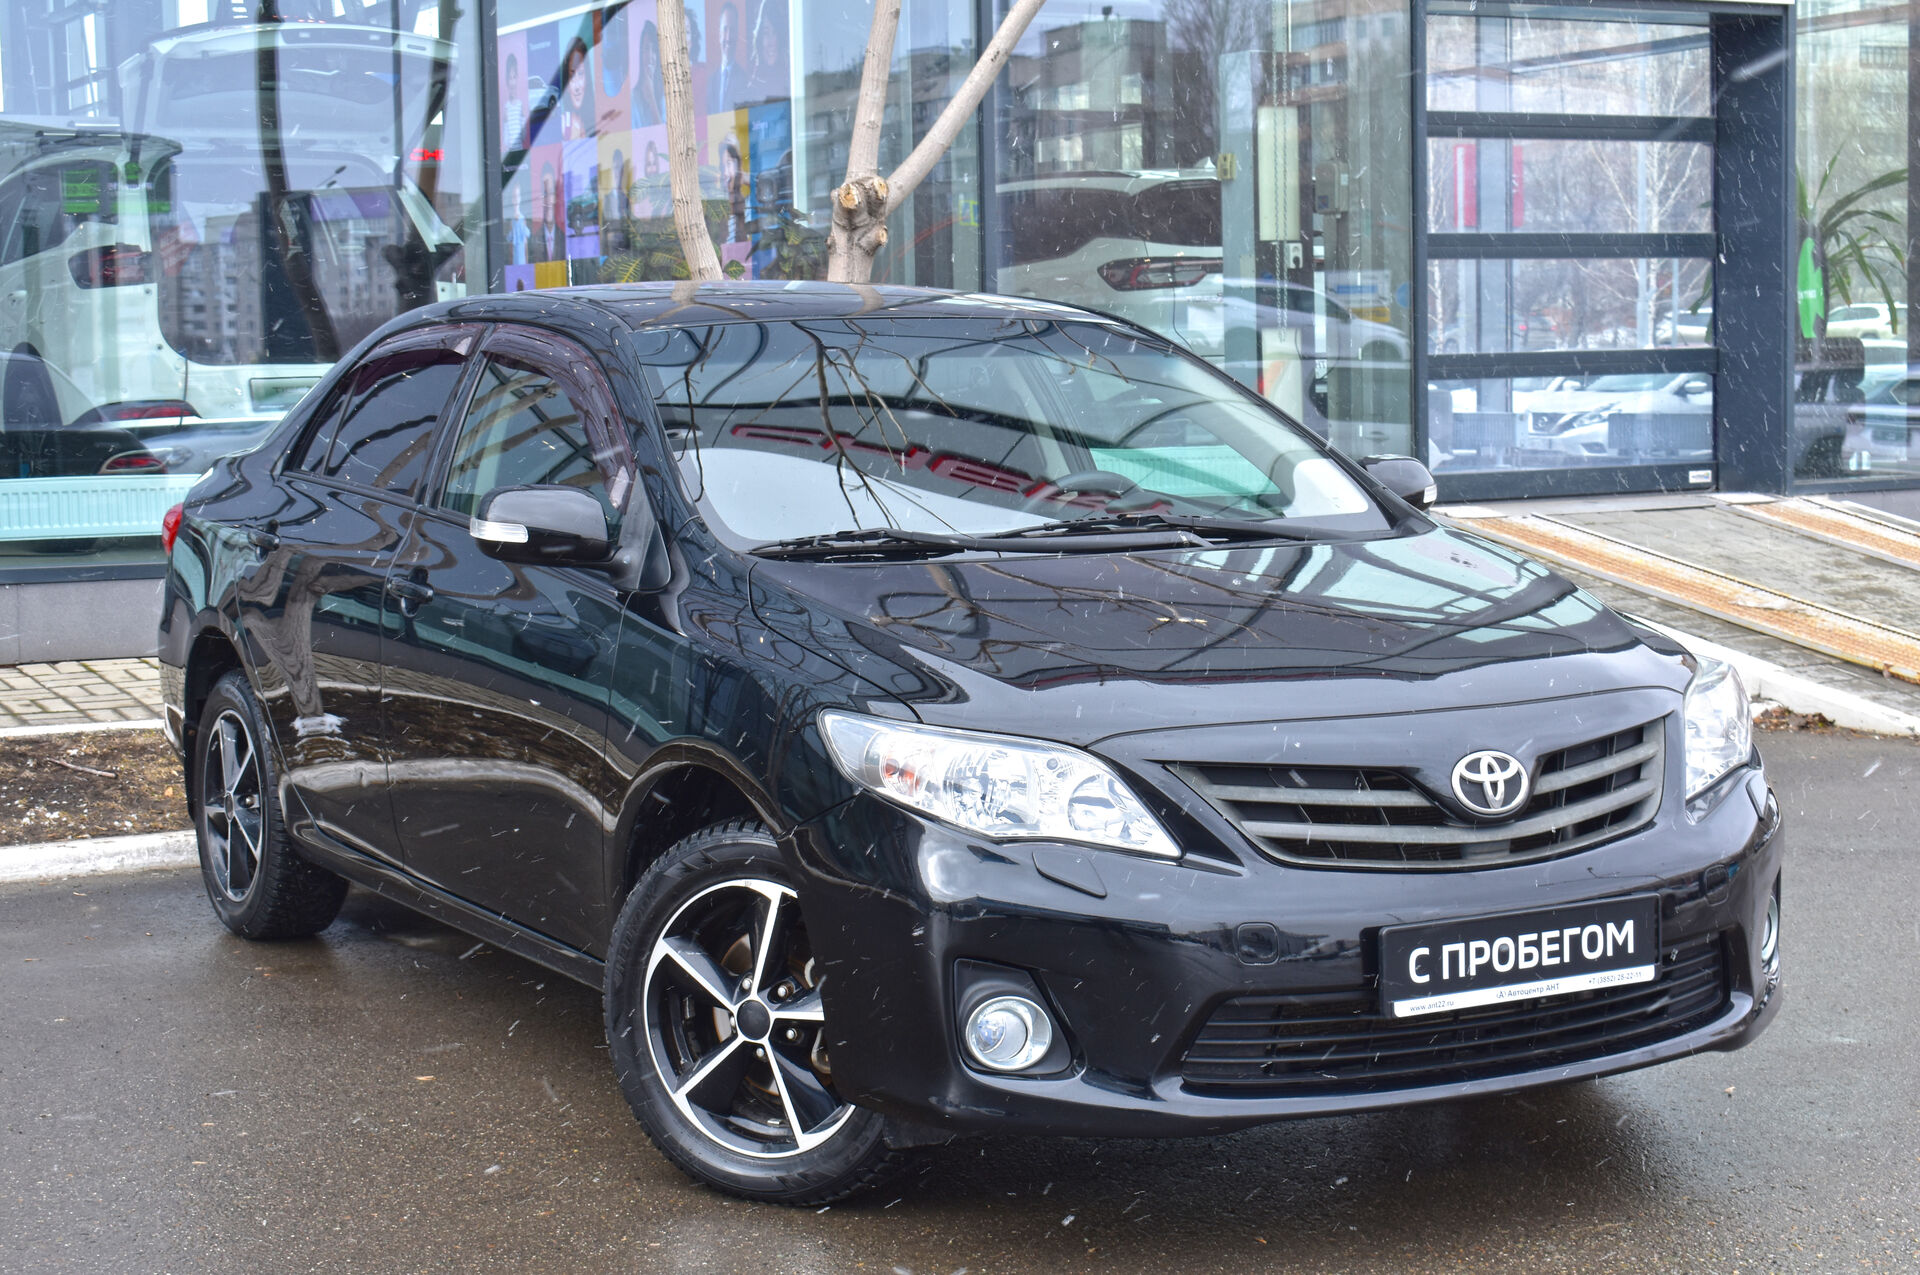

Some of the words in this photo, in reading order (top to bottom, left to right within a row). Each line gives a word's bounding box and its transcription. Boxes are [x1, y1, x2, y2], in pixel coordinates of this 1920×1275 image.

[1408, 947, 1430, 983] С
[1442, 920, 1634, 980] ПРОБЕГОМ
[1507, 984, 1544, 997] Автоцентр
[1545, 982, 1560, 993] АНТ
